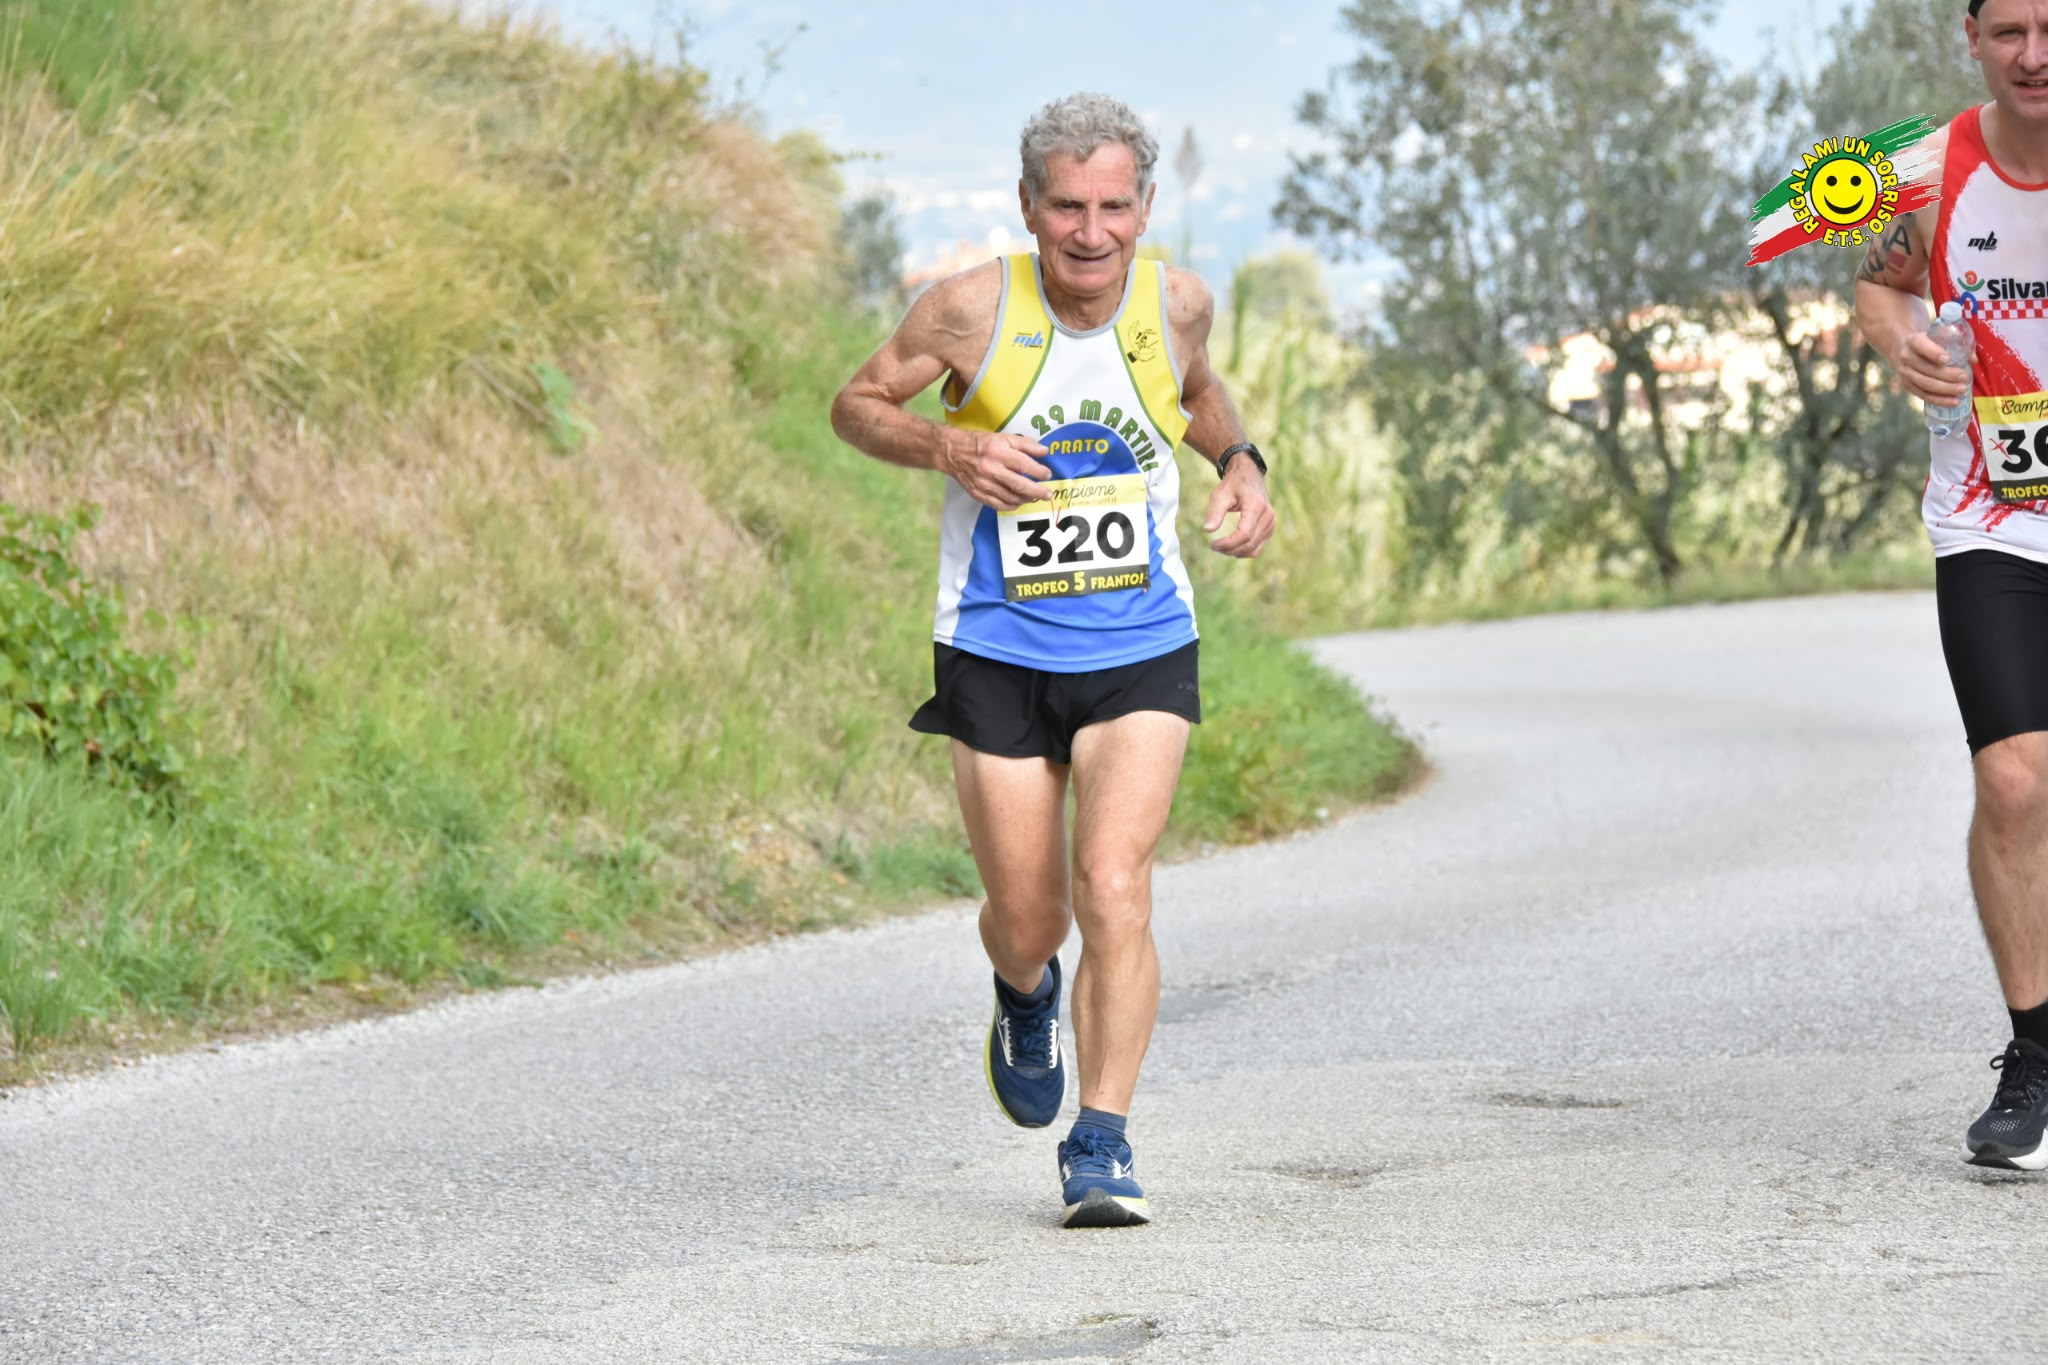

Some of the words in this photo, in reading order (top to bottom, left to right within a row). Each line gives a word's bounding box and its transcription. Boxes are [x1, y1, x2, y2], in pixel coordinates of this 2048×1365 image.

[1987, 278, 2048, 300] Silva
[1031, 404, 1064, 436] 29
[1050, 438, 1110, 456] PRATO
[1031, 484, 1117, 507] mpione
[1017, 511, 1135, 567] 320
[1016, 580, 1069, 597] TROFEO
[1073, 571, 1086, 591] 5
